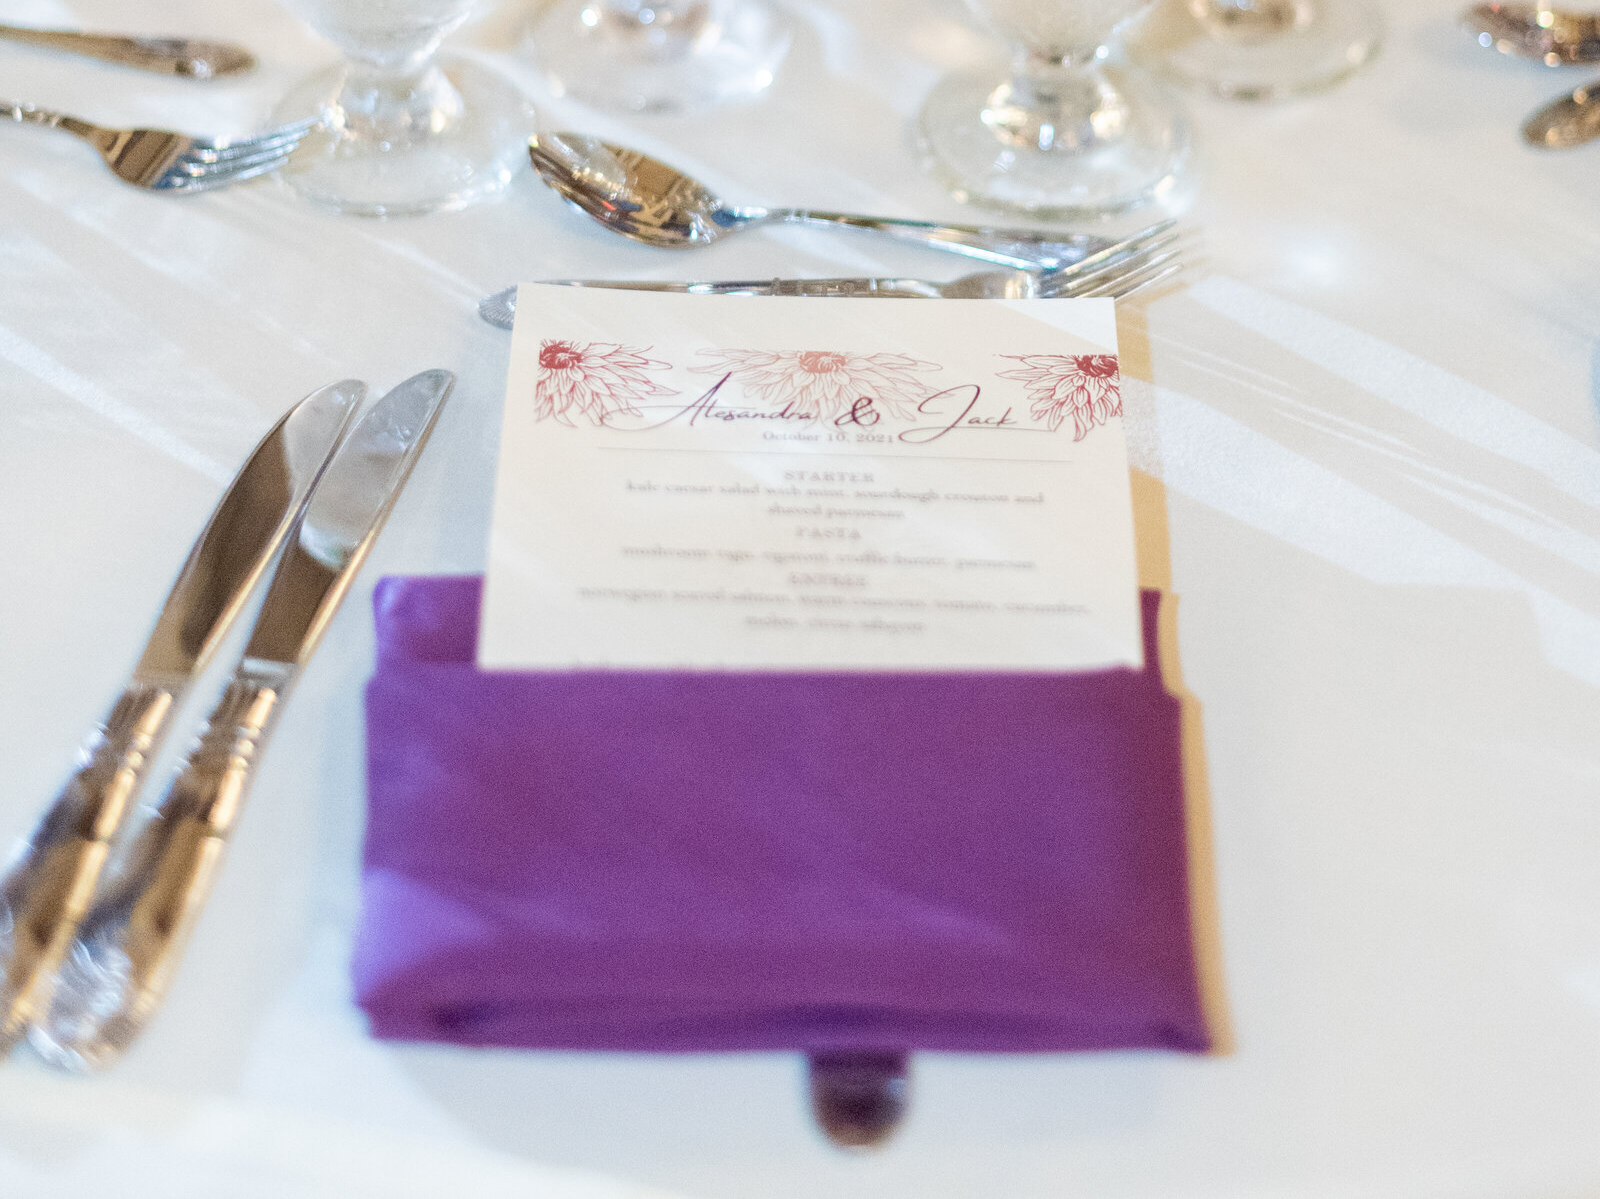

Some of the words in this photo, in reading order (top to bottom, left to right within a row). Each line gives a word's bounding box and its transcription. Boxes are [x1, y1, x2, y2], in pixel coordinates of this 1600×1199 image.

[834, 396, 880, 426] &
[898, 384, 1052, 443] Jack
[763, 430, 820, 443] October
[826, 432, 850, 444] 10,
[856, 433, 894, 444] 2021
[784, 471, 874, 483] STARTER
[625, 479, 659, 493] kale
[664, 483, 714, 494] caesar
[719, 482, 760, 495] salad
[854, 488, 940, 503] sourdough
[1014, 491, 1046, 504] and
[796, 526, 862, 540] PASTA
